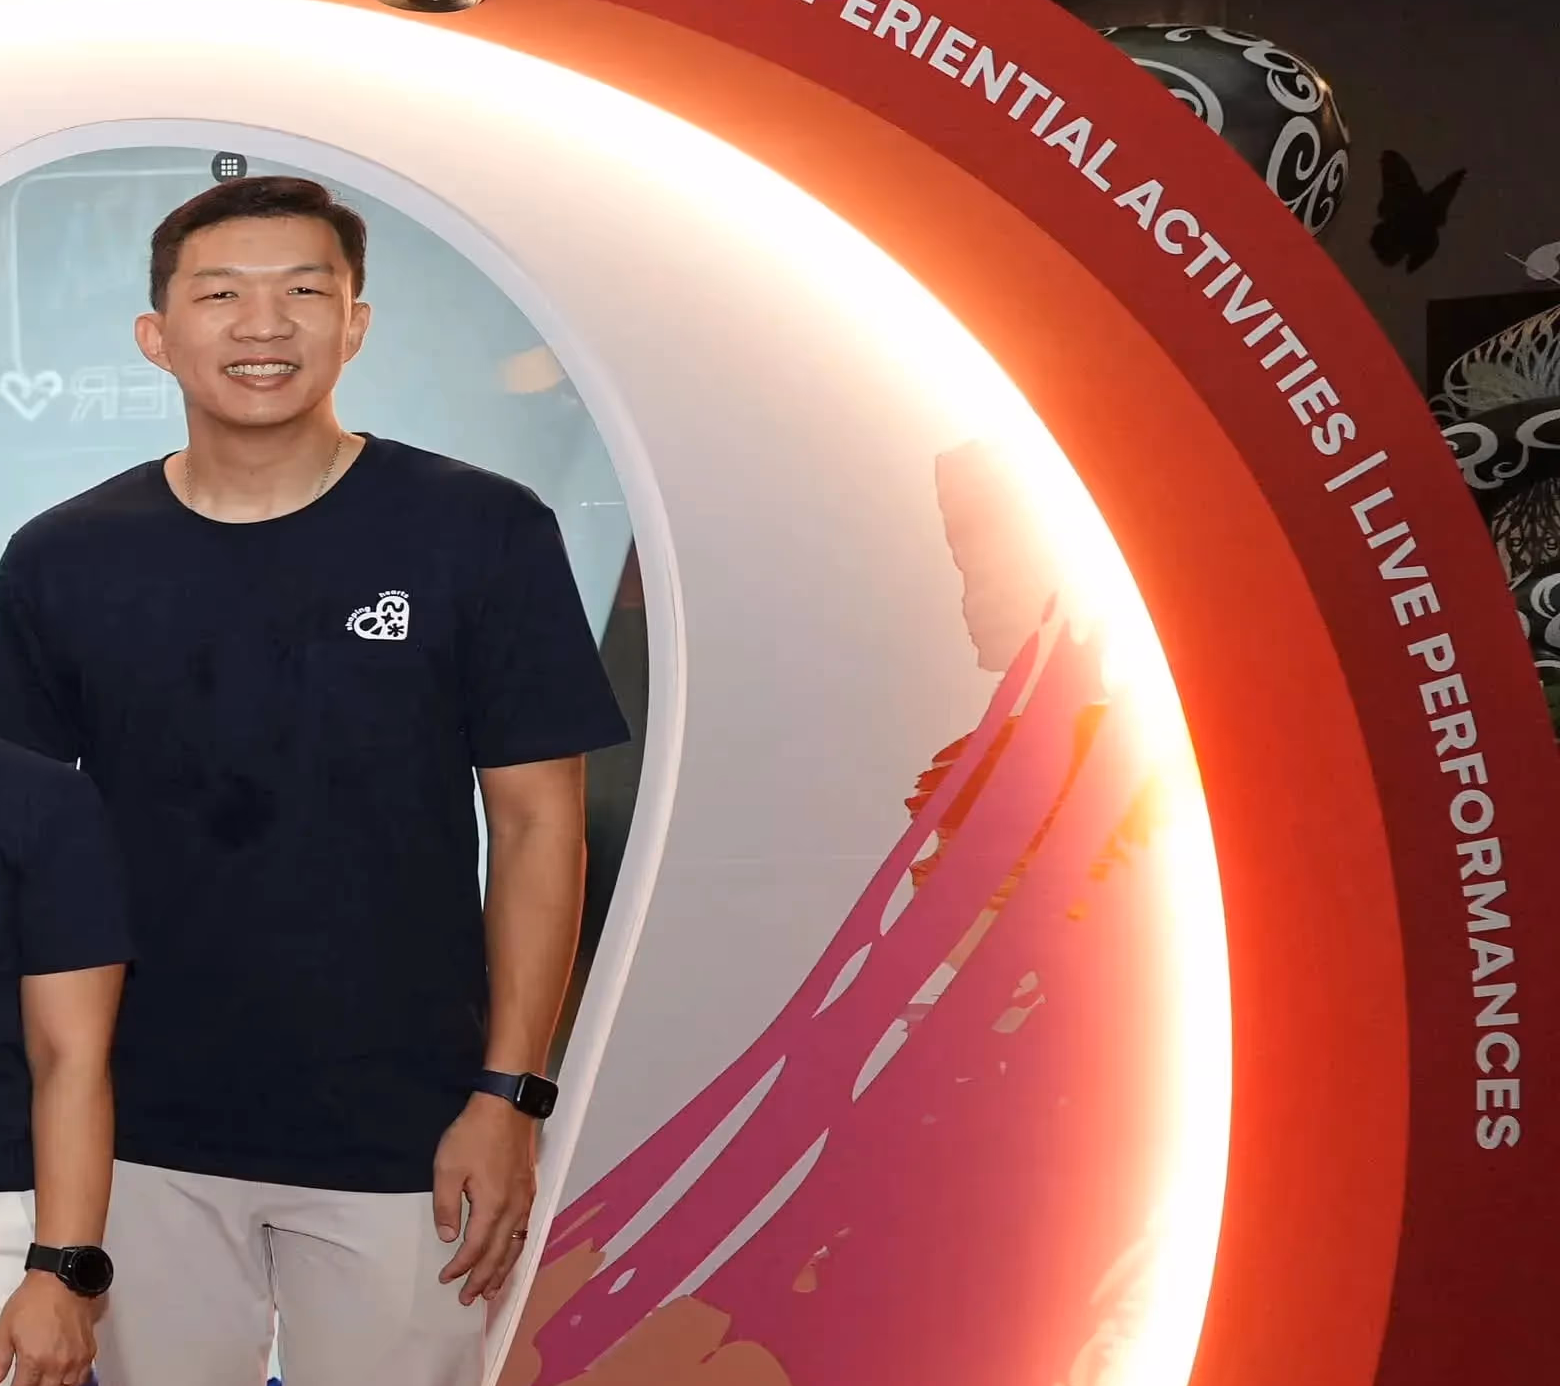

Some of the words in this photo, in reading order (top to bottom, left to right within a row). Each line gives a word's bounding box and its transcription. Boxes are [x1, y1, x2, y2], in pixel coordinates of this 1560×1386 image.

[1112, 176, 1358, 456] ACTIVITIES
[1350, 486, 1443, 626] LIVE
[1406, 631, 1522, 1152] PERFORMANCES
